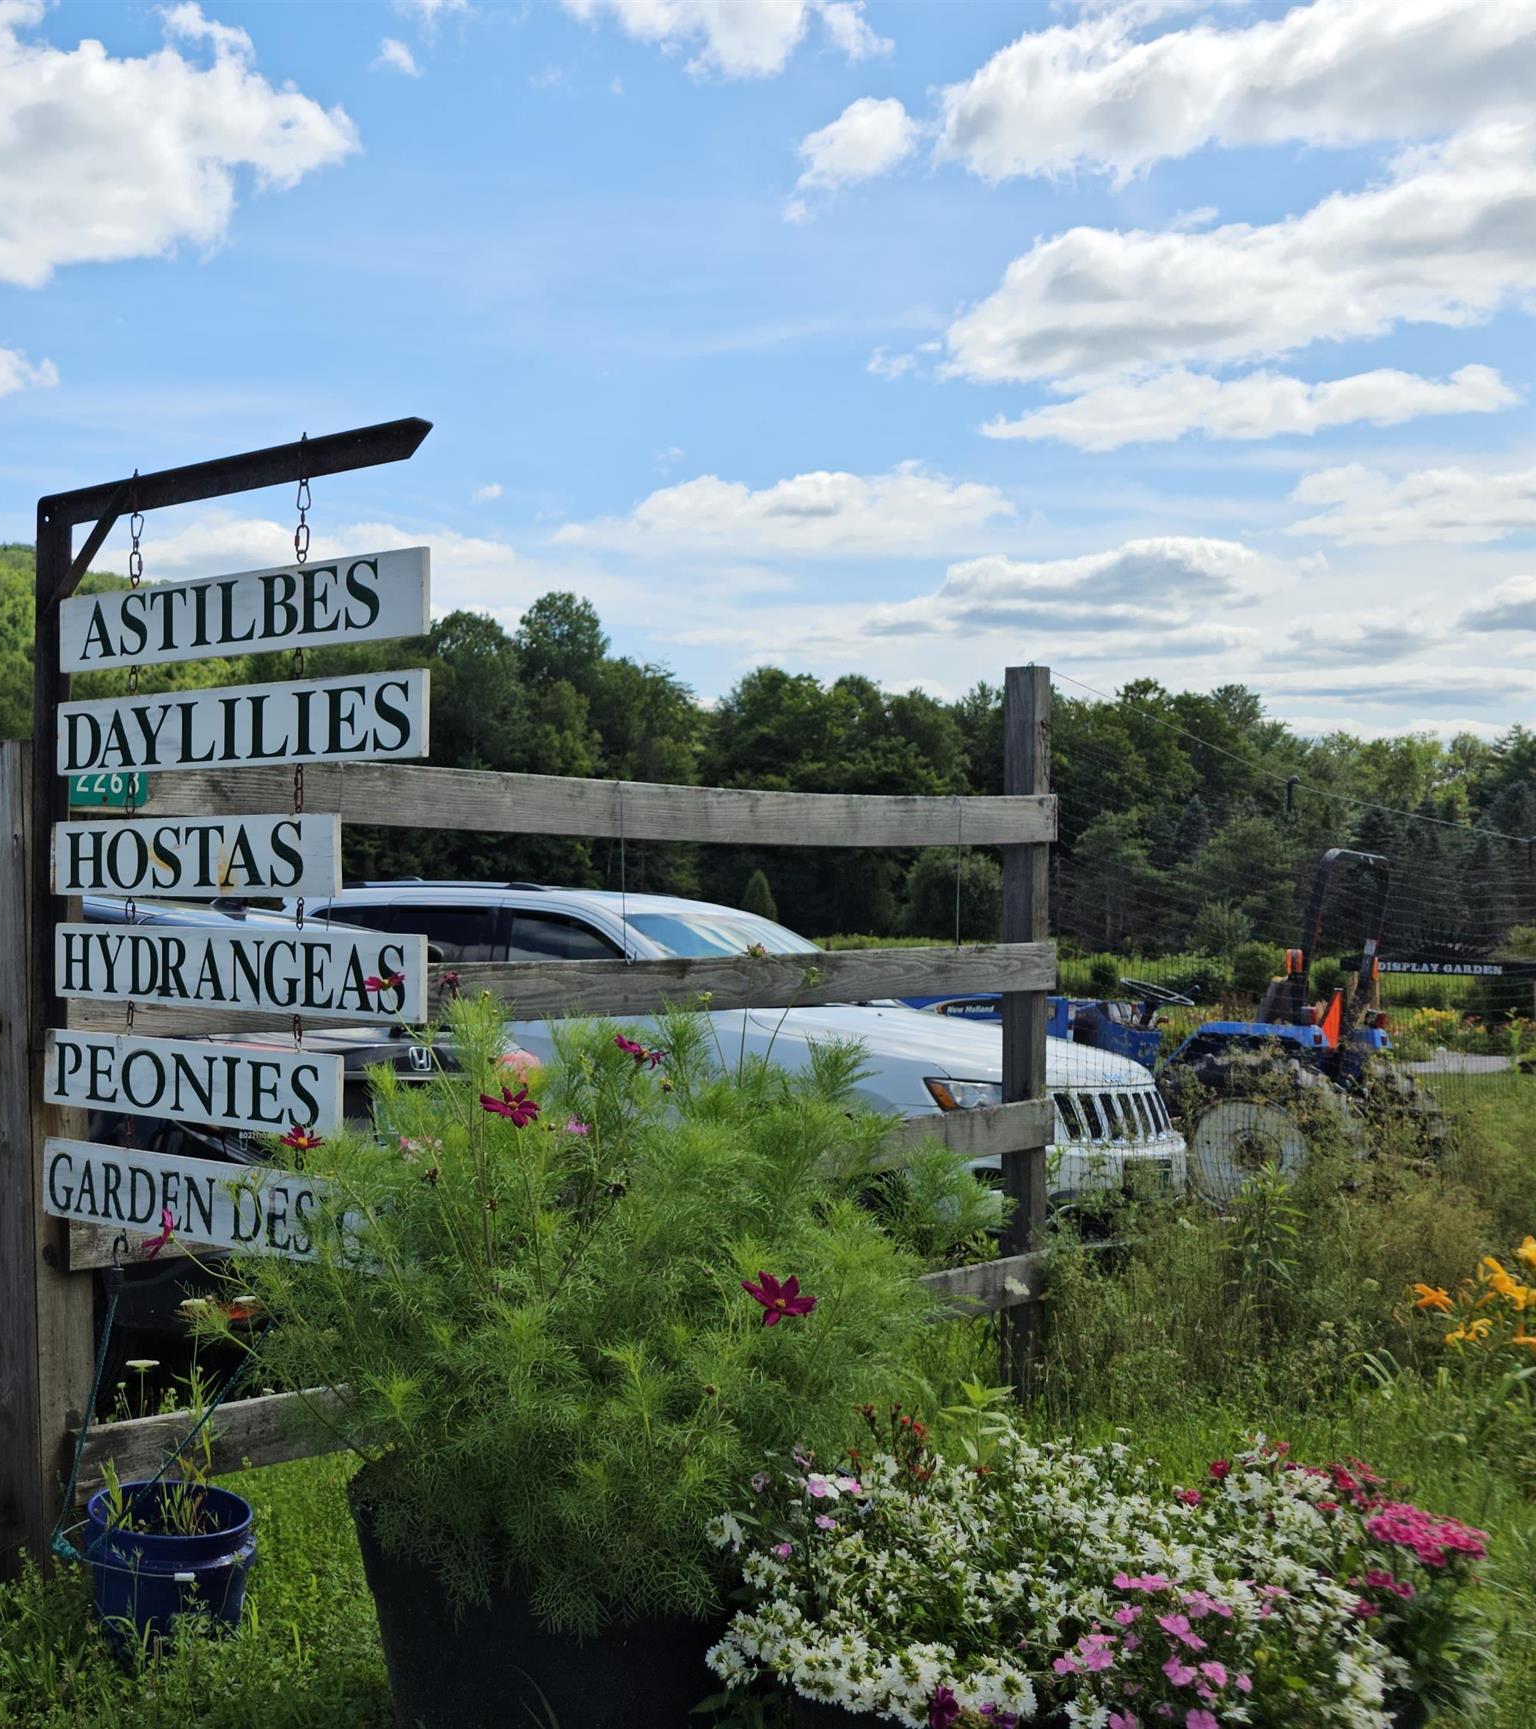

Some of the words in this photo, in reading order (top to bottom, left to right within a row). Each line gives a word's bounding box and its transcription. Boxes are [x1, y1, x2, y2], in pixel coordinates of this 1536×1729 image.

[79, 559, 380, 661] ASTILBES
[64, 681, 411, 771] DAYLILIES
[65, 821, 304, 890] HOSTAS
[62, 932, 406, 1014] HYDRANGEAS
[947, 1006, 964, 1014] New
[965, 1005, 995, 1014] Holland
[1377, 962, 1440, 973] DISPLAY
[1443, 963, 1504, 976] GARDEN
[54, 1041, 320, 1129] PEONIES
[48, 1152, 216, 1236] GARDEN
